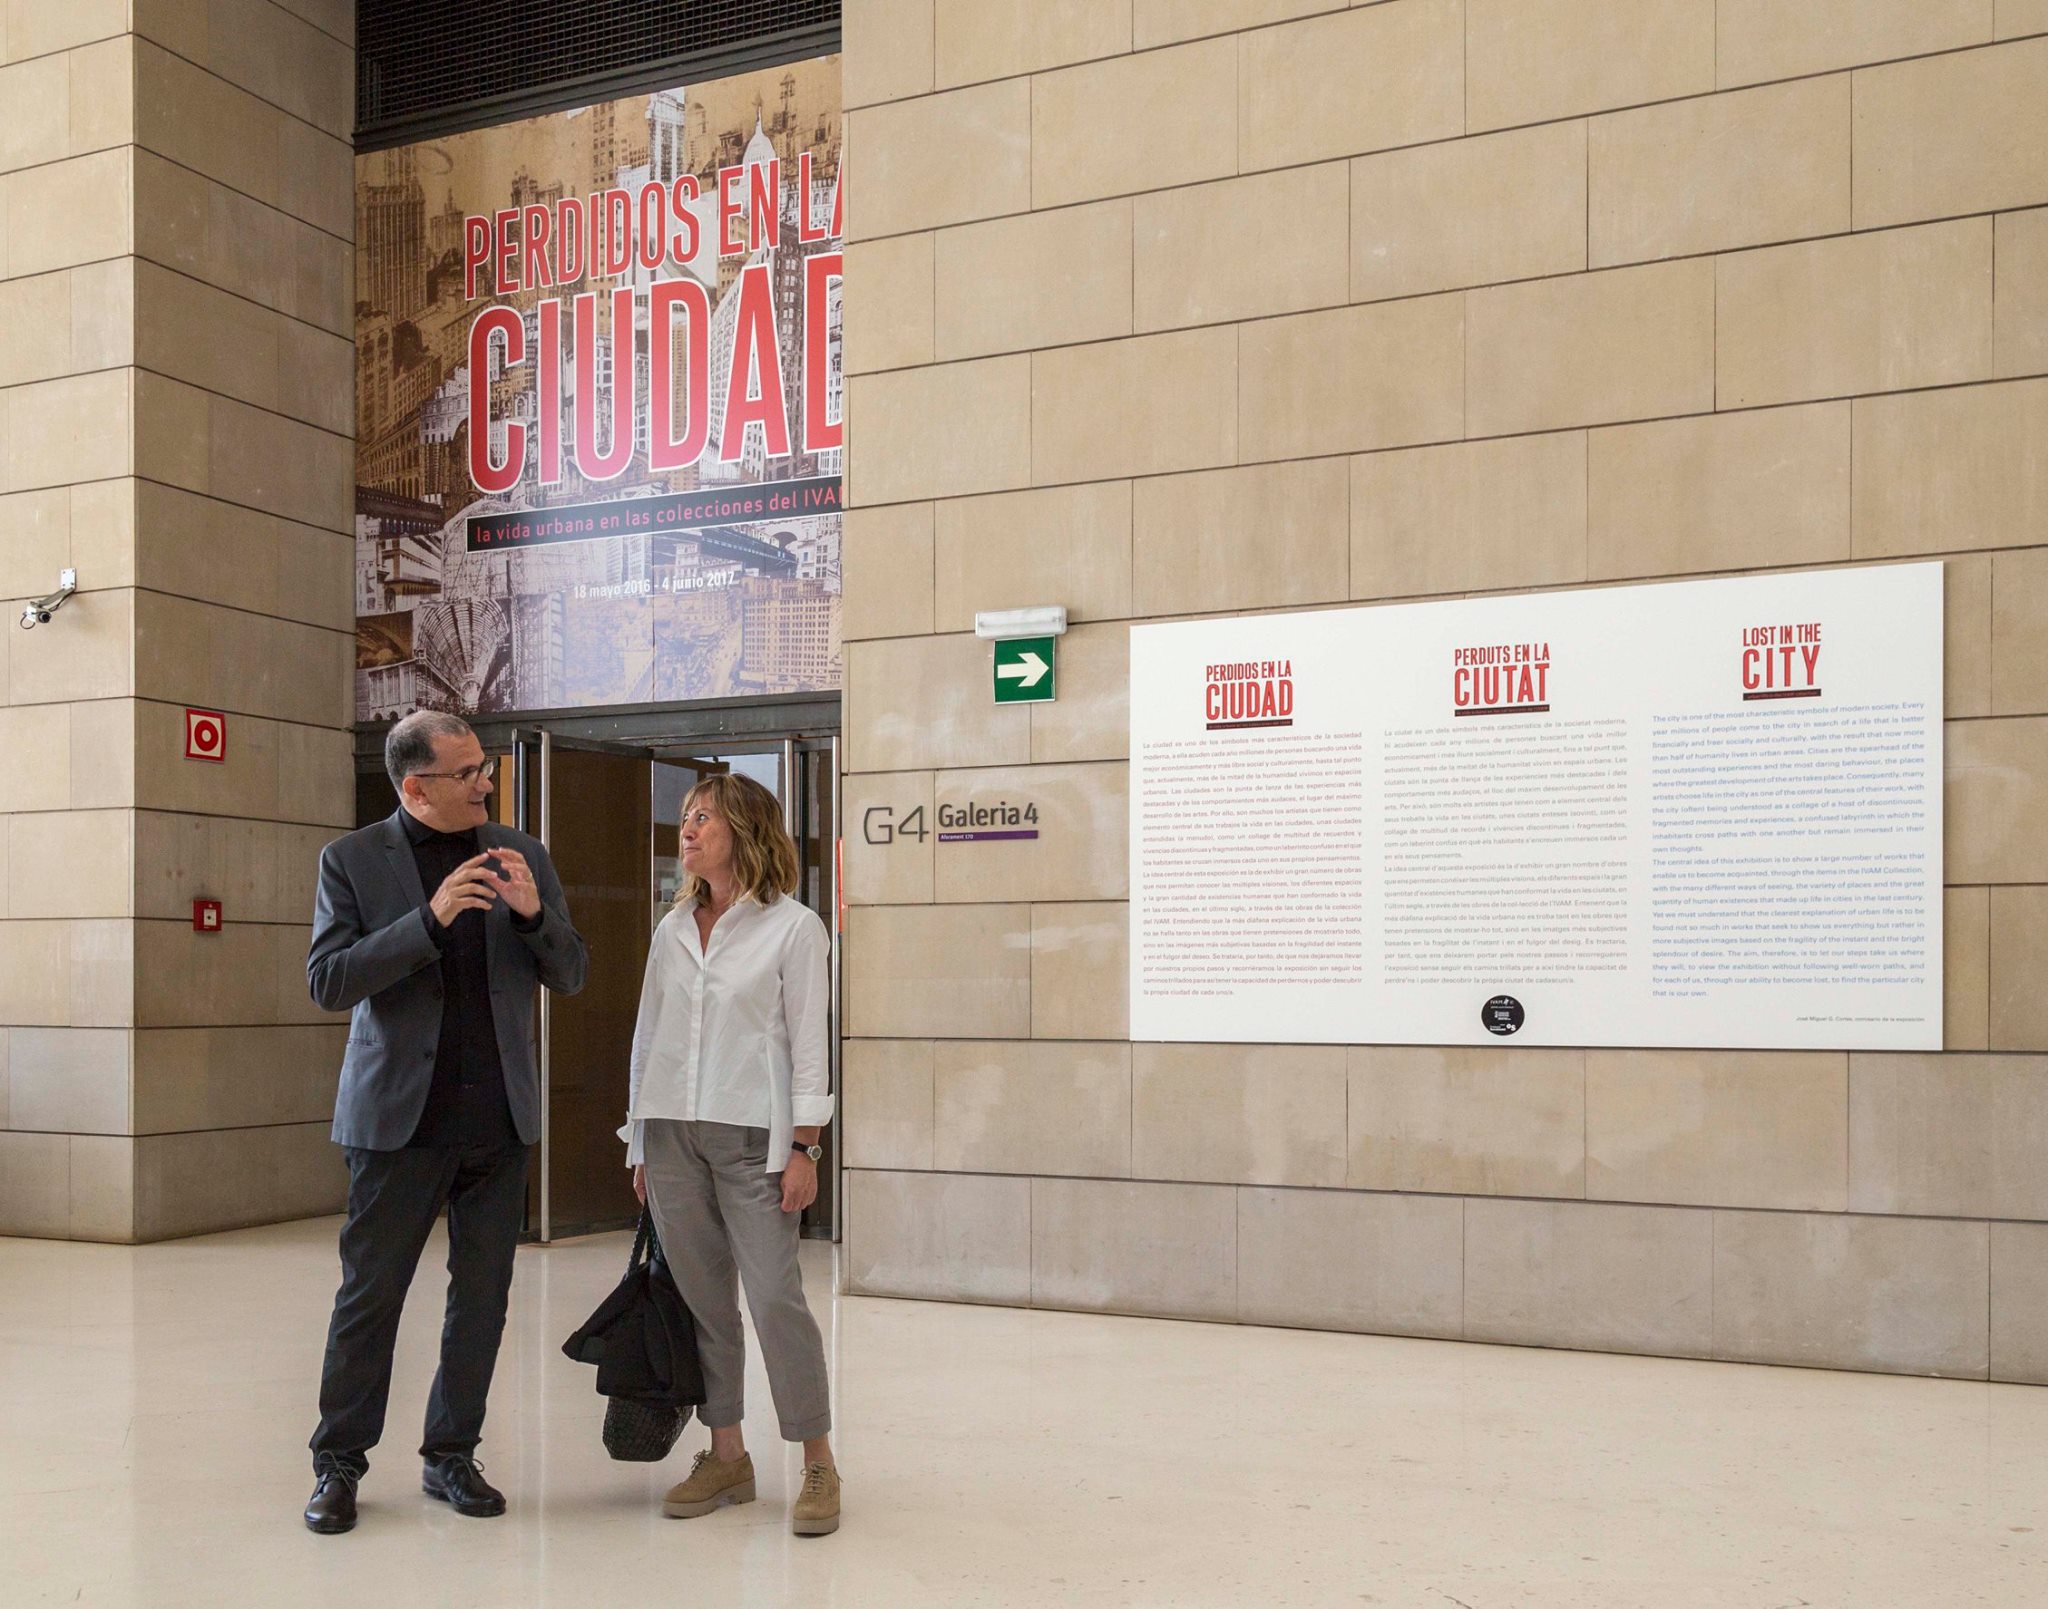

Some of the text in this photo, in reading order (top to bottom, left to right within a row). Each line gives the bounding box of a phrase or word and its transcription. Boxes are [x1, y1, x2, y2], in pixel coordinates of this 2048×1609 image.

[464, 174, 701, 301] PERDIDOS
[717, 157, 781, 260] EN
[476, 485, 842, 543] la vida urbana en las colecciones del IVA
[574, 585, 586, 599] 18
[589, 584, 621, 600] mayo
[623, 579, 650, 595] 2016
[662, 576, 669, 591] 4
[672, 574, 704, 593] junio
[706, 571, 735, 587] 2017
[1454, 642, 1550, 667] PERDUTS EN LA
[1743, 622, 1822, 647] LOST IN THE
[1206, 659, 1292, 682] PERDIDOS EN LA
[1454, 663, 1550, 706] CIUTAT
[1742, 644, 1820, 690] CITY
[1206, 679, 1294, 720] CIUDAD
[863, 805, 930, 845] G4
[938, 801, 1039, 829] Galeria 4
